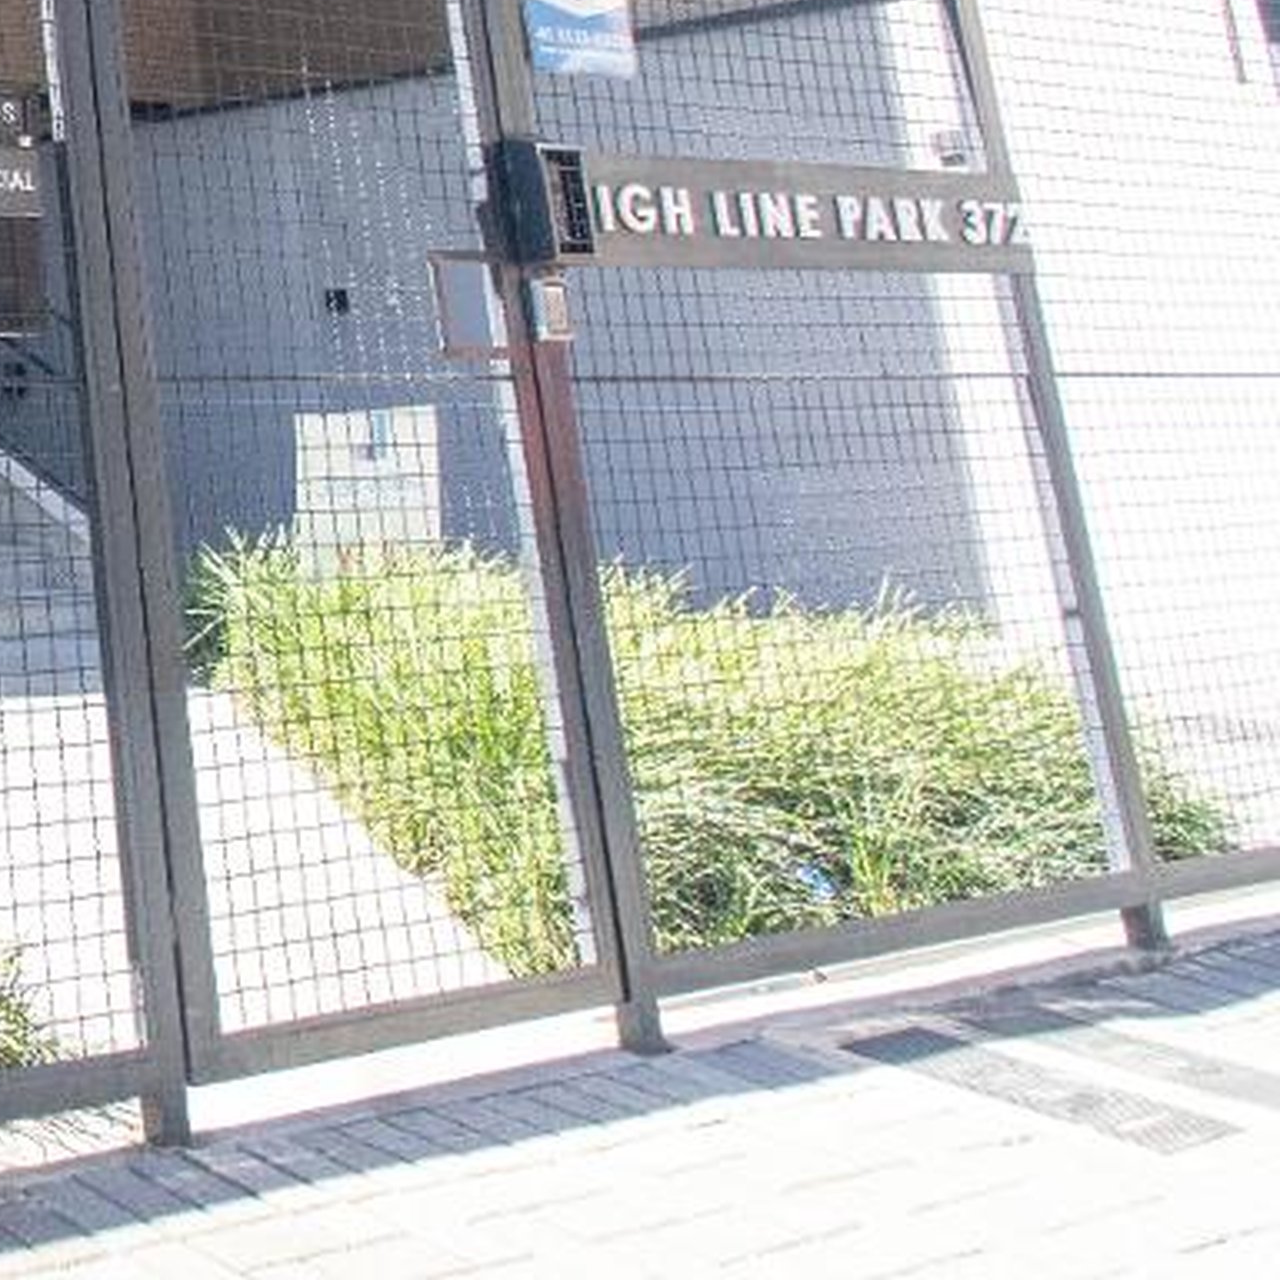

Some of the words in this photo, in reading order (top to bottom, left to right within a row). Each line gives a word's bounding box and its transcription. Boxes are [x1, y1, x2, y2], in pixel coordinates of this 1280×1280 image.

[595, 185, 696, 235] IGH
[712, 189, 823, 239] LINE
[836, 194, 951, 241] PARK
